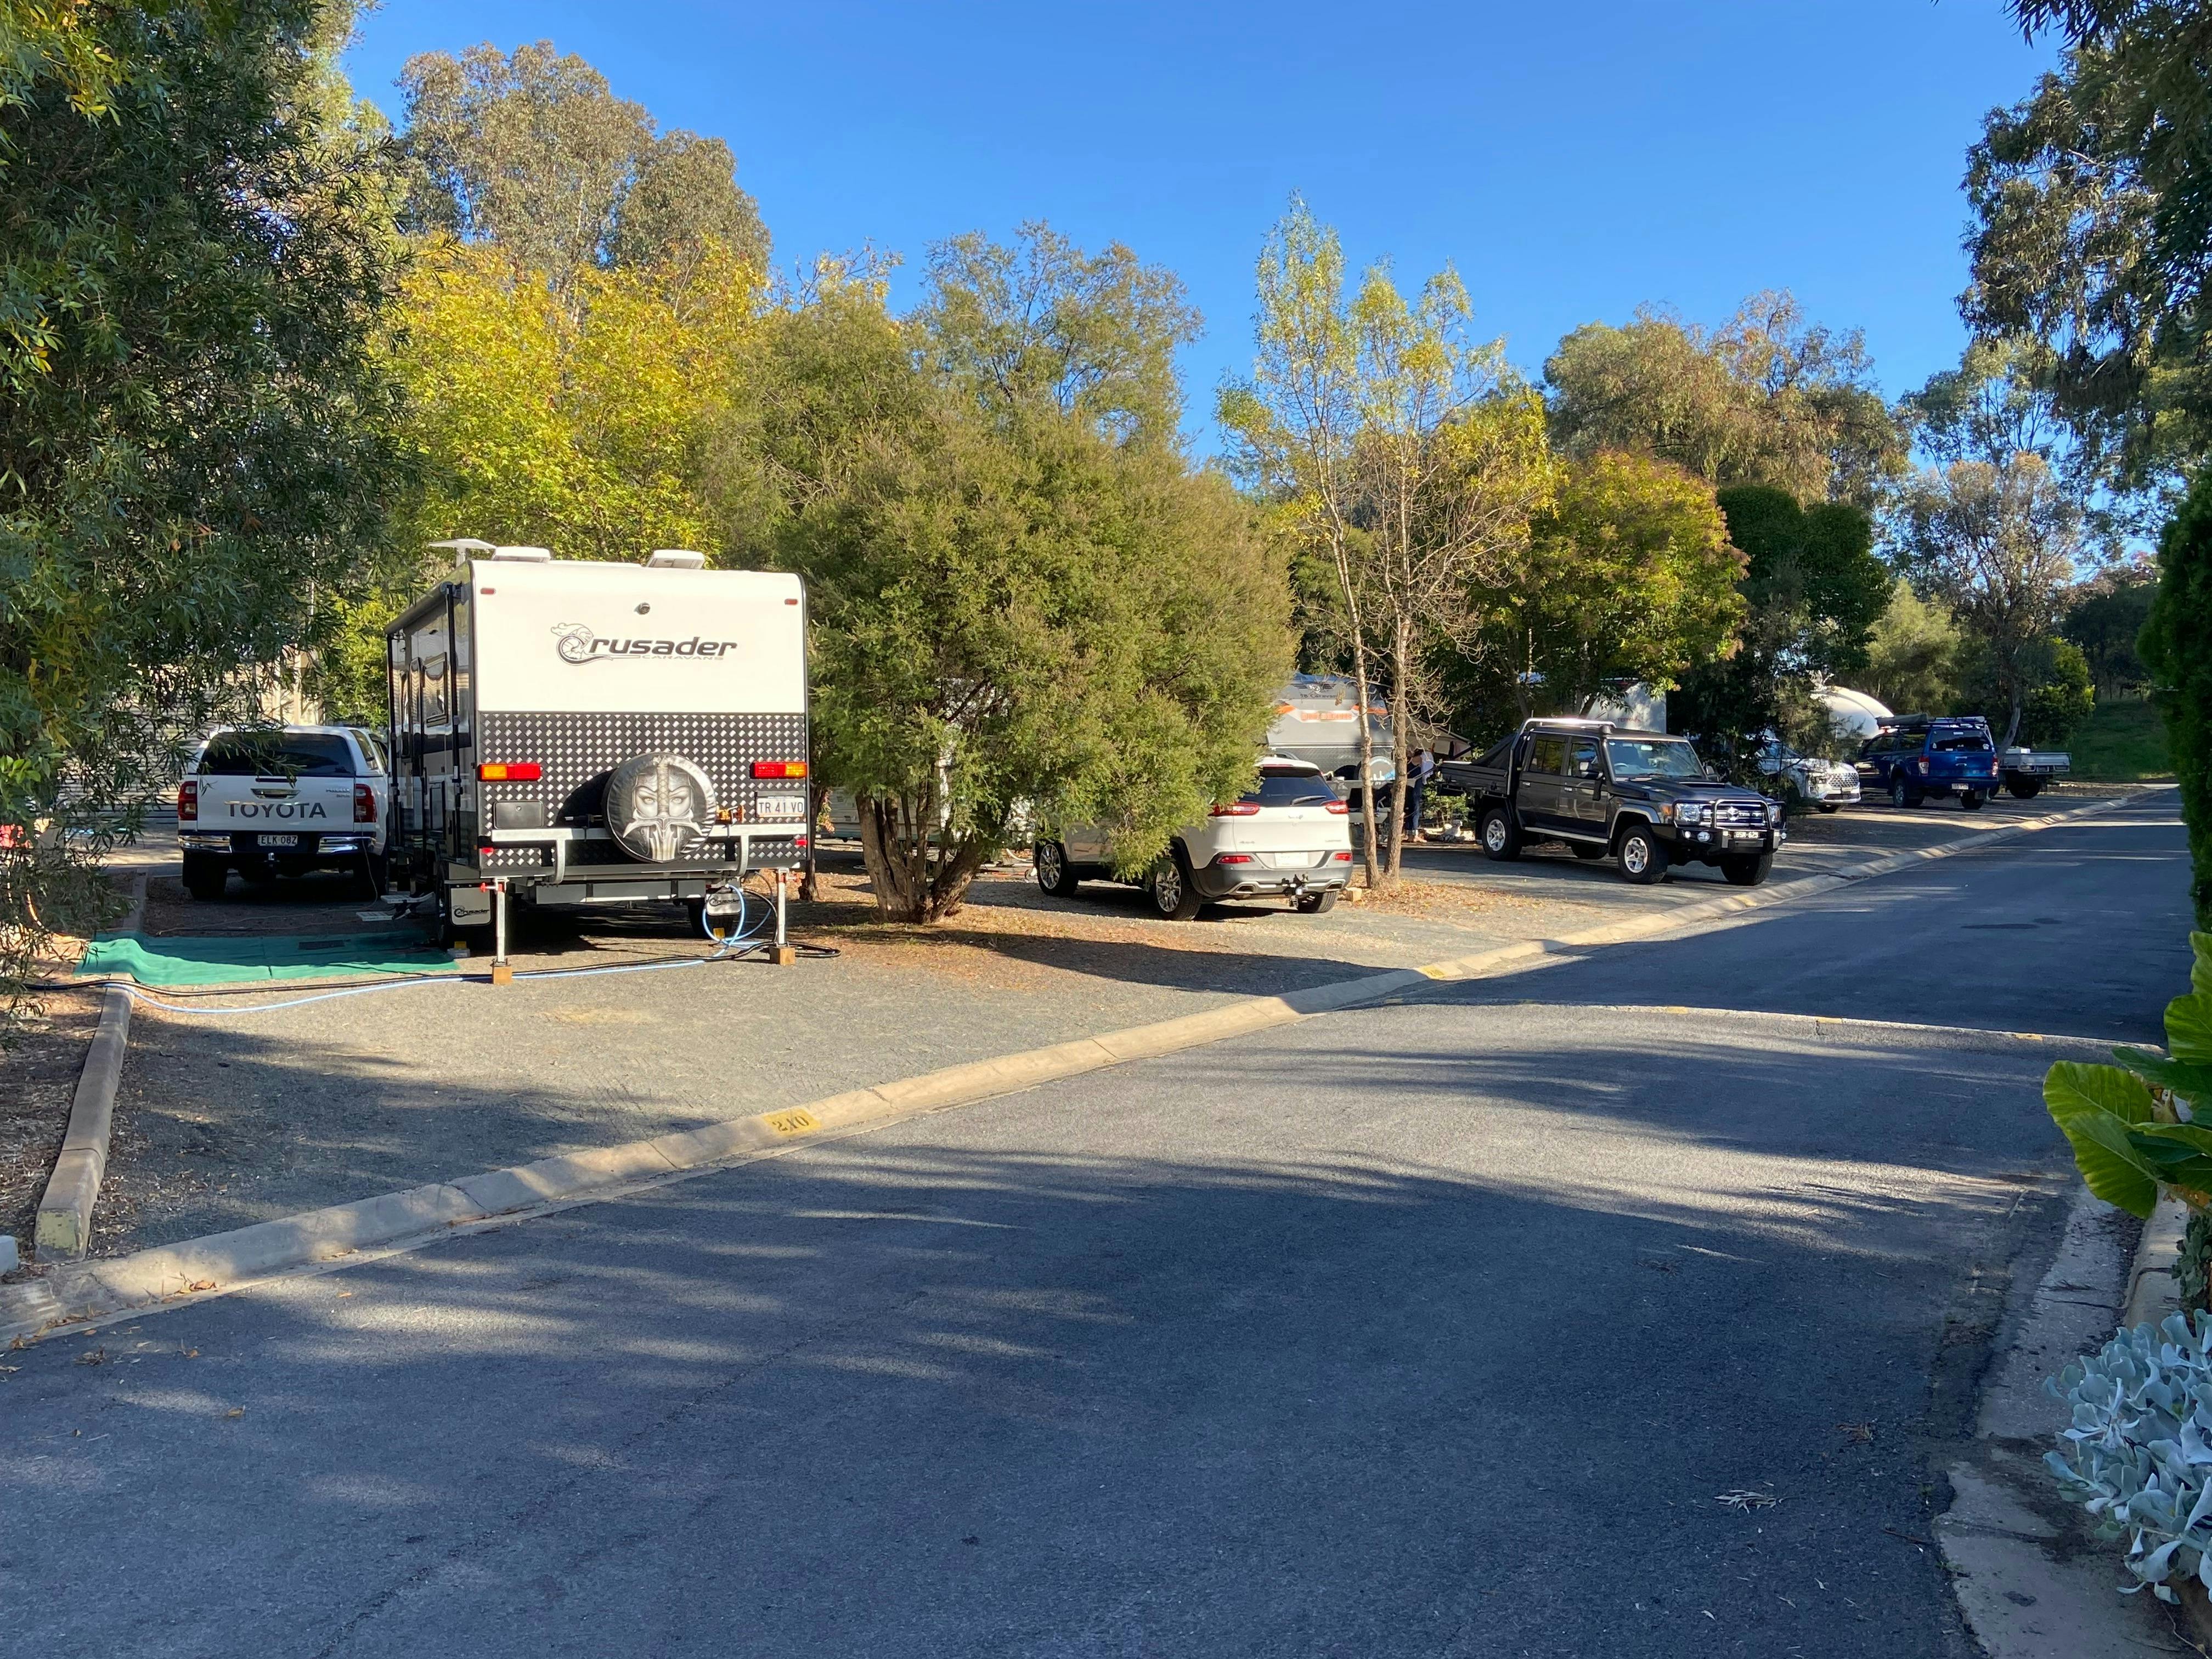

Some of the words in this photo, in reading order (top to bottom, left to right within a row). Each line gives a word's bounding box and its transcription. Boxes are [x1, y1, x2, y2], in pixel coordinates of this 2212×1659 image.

[556, 634, 738, 667] Crusader
[224, 801, 327, 819] TOYOTA
[758, 802, 771, 813] TR
[775, 802, 786, 813] 41
[261, 836, 276, 844] ELK
